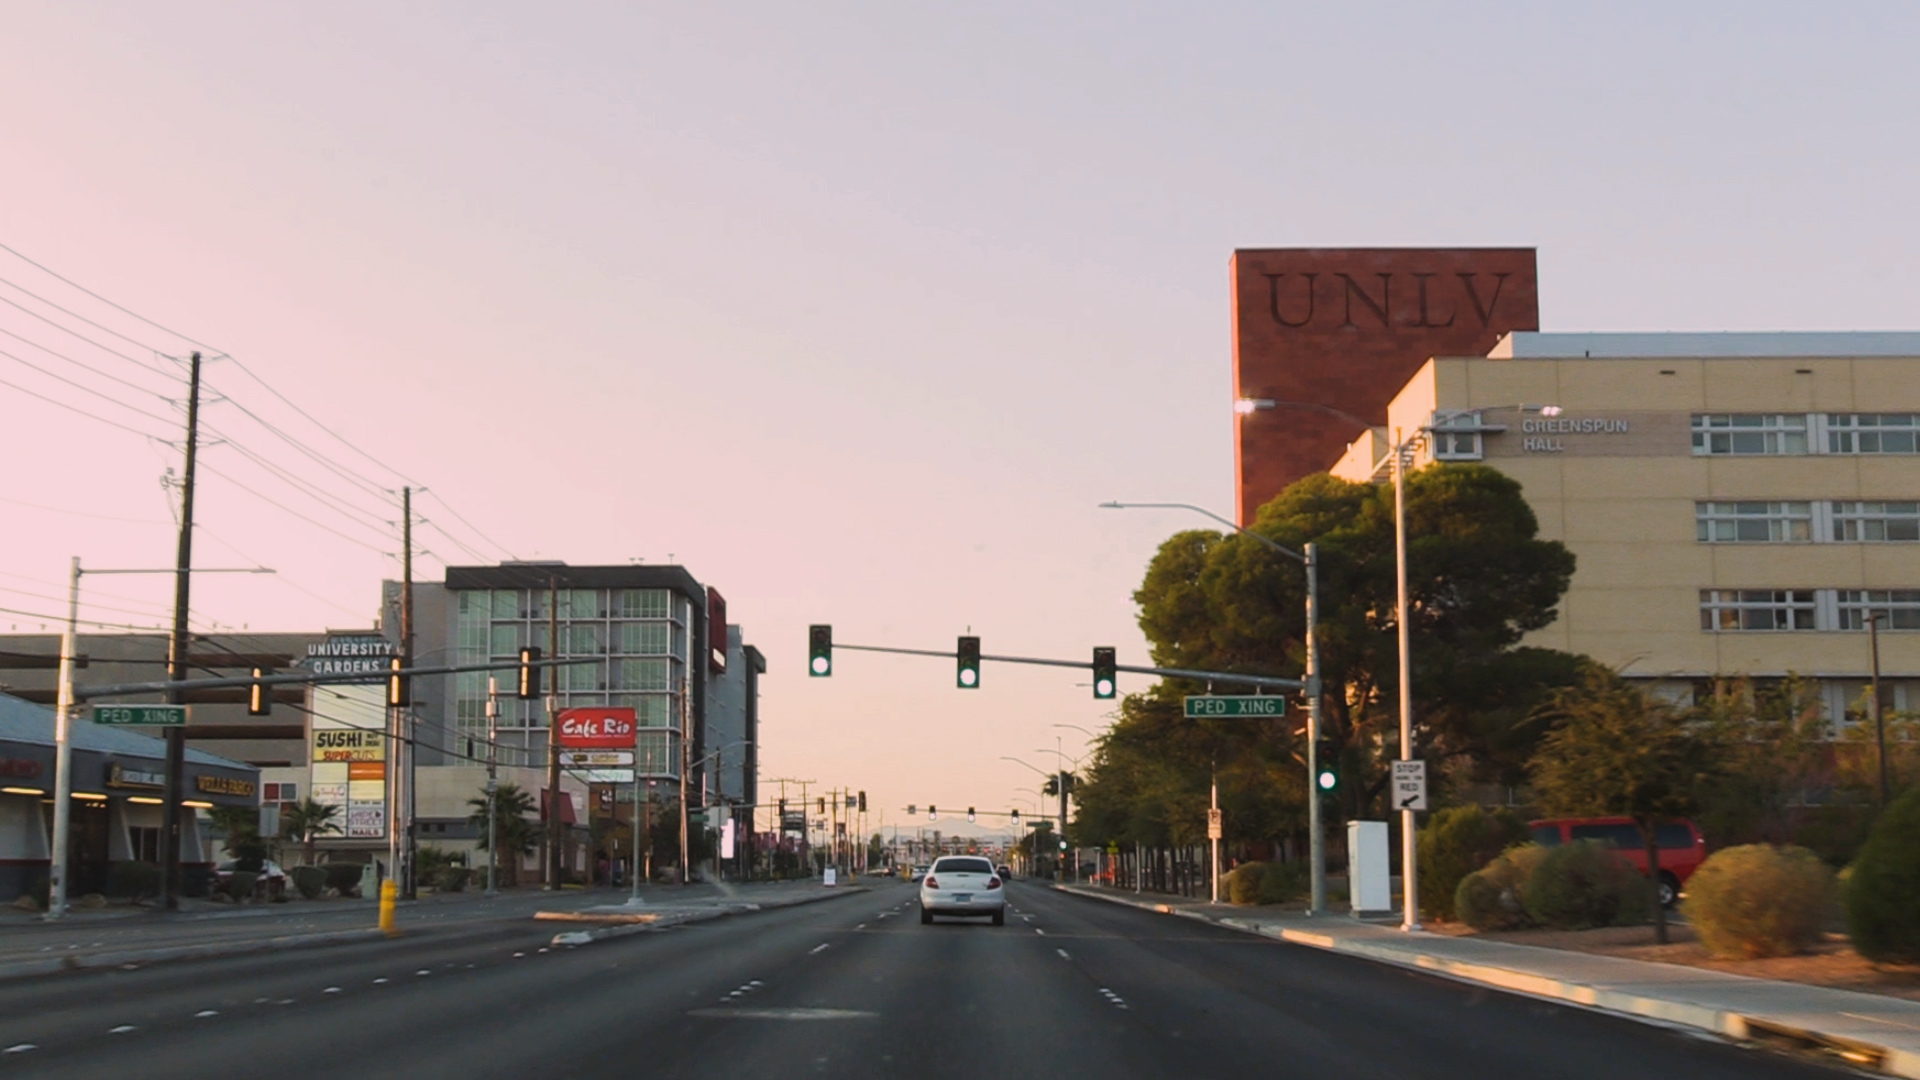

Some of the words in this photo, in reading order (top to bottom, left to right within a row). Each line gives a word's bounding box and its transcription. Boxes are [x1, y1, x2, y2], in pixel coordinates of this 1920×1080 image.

[1261, 272, 1514, 329] UNLV
[1522, 419, 1628, 433] GREENSPUN
[1523, 438, 1564, 451] HALL
[307, 642, 392, 656] UNIVERSITY
[313, 660, 380, 673] GARDENS
[1194, 700, 1227, 714] PED
[1238, 700, 1276, 714] XING
[101, 708, 132, 722] PED
[141, 709, 179, 722] XING
[562, 718, 598, 738] Cafe
[603, 718, 630, 734] Rio
[316, 732, 362, 748] SUSHI
[323, 749, 376, 760] SUPERCUTS
[1396, 764, 1421, 773] STOP
[1400, 782, 1419, 791] RED
[352, 827, 379, 836] NAILS
